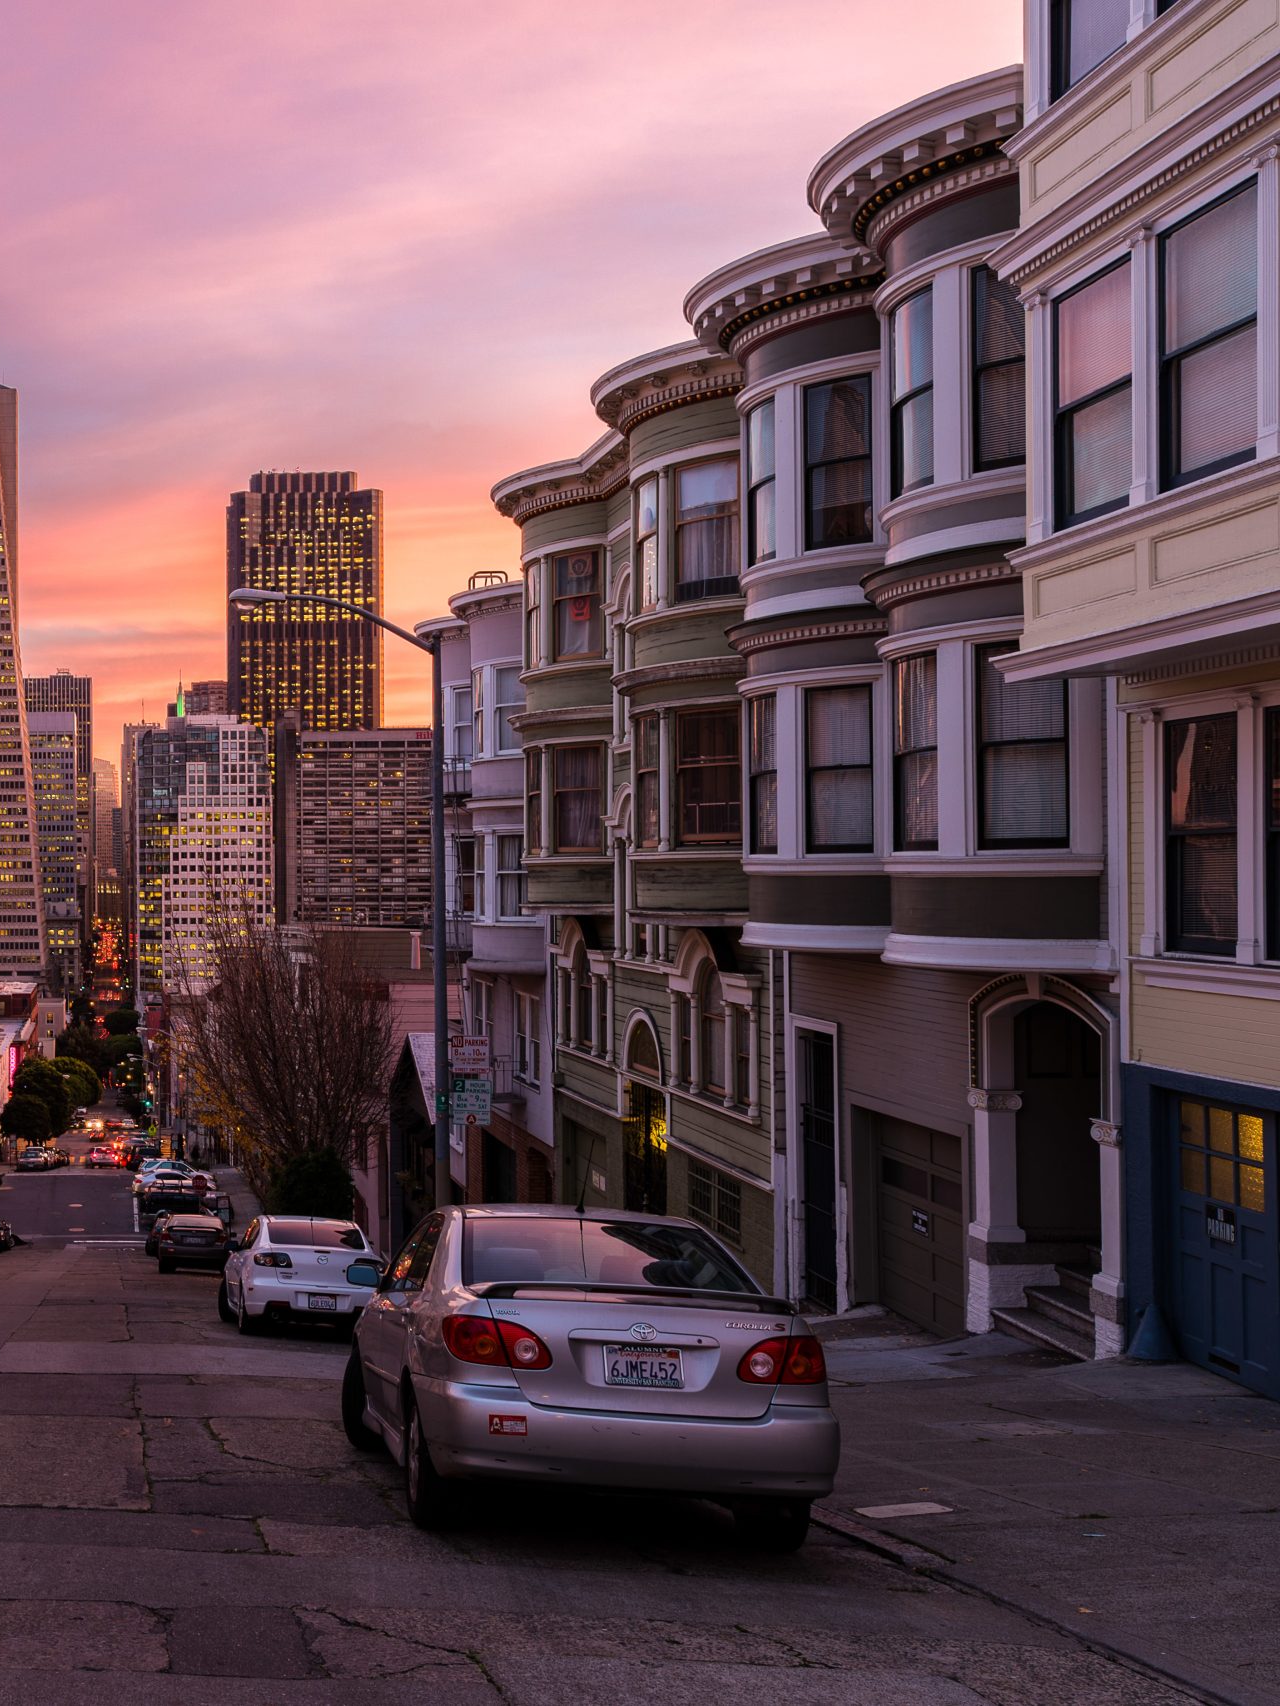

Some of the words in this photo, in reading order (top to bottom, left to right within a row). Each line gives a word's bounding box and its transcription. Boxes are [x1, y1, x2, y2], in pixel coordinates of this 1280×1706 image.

[415, 731, 433, 739] Hilt
[453, 1037, 463, 1047] NO
[455, 1081, 463, 1091] 2
[1207, 1217, 1235, 1242] PARKING
[495, 1308, 520, 1316] TOYOTA
[725, 1322, 772, 1331] COROLLA
[773, 1323, 786, 1331] S
[611, 1360, 678, 1381] 6JME452
